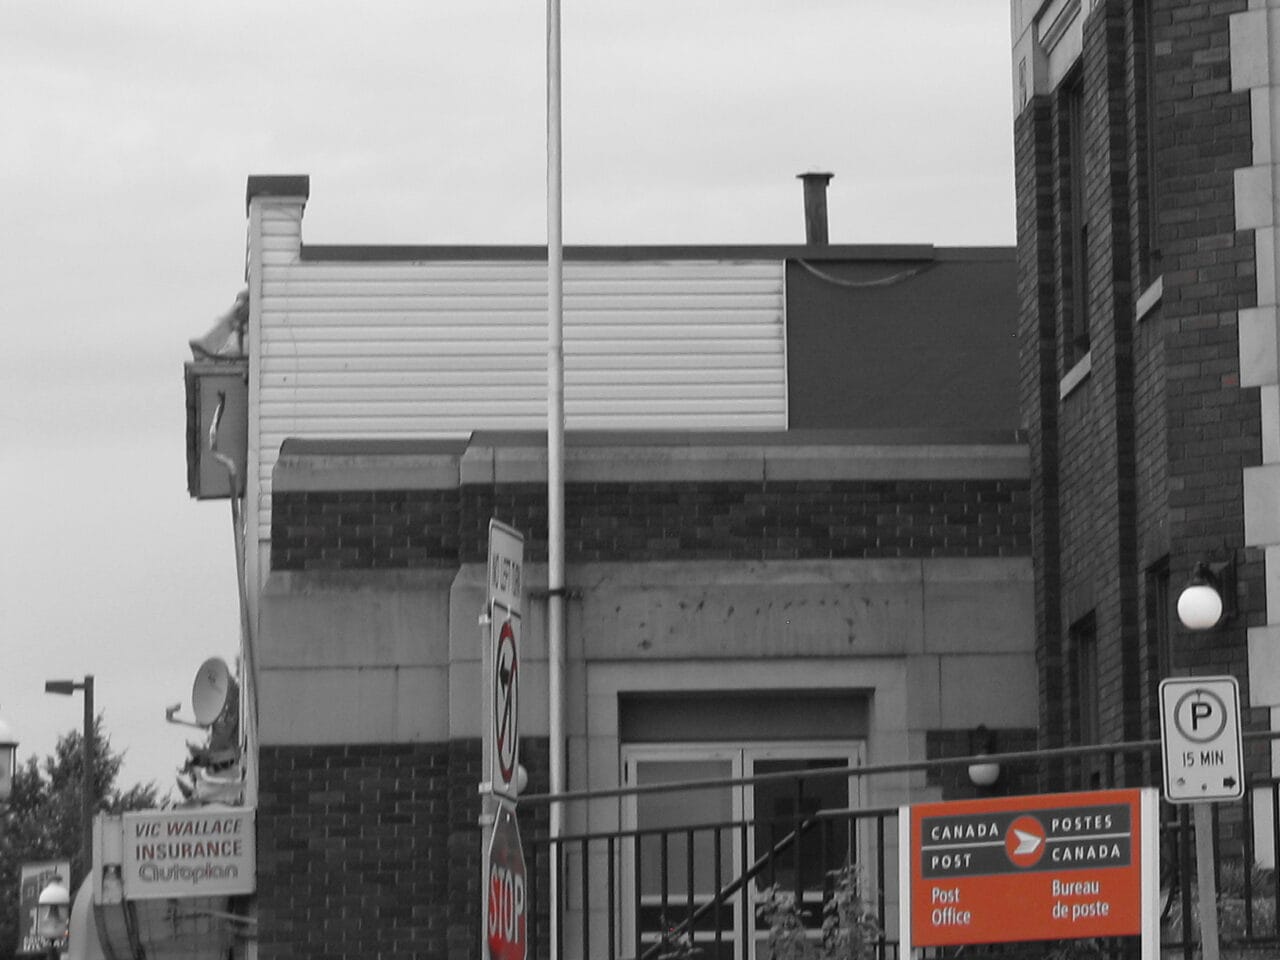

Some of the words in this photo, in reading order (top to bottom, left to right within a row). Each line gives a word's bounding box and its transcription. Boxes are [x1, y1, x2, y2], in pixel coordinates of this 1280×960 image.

[1191, 702, 1212, 731] P
[1182, 750, 1195, 768] 15
[1201, 749, 1224, 767] MIN
[136, 822, 161, 838] VIC
[167, 818, 243, 837] WALLACE
[931, 822, 999, 840] CANADA
[1051, 814, 1113, 832] POSTES
[136, 840, 242, 861] INSURANCE
[1051, 844, 1121, 862] CANADA
[931, 853, 972, 870] POST
[931, 887, 960, 905] Post
[1052, 879, 1100, 897] Bureau
[489, 863, 524, 944] STOP
[1052, 901, 1069, 919] de
[1072, 900, 1110, 921] poste
[931, 907, 971, 926] Office
